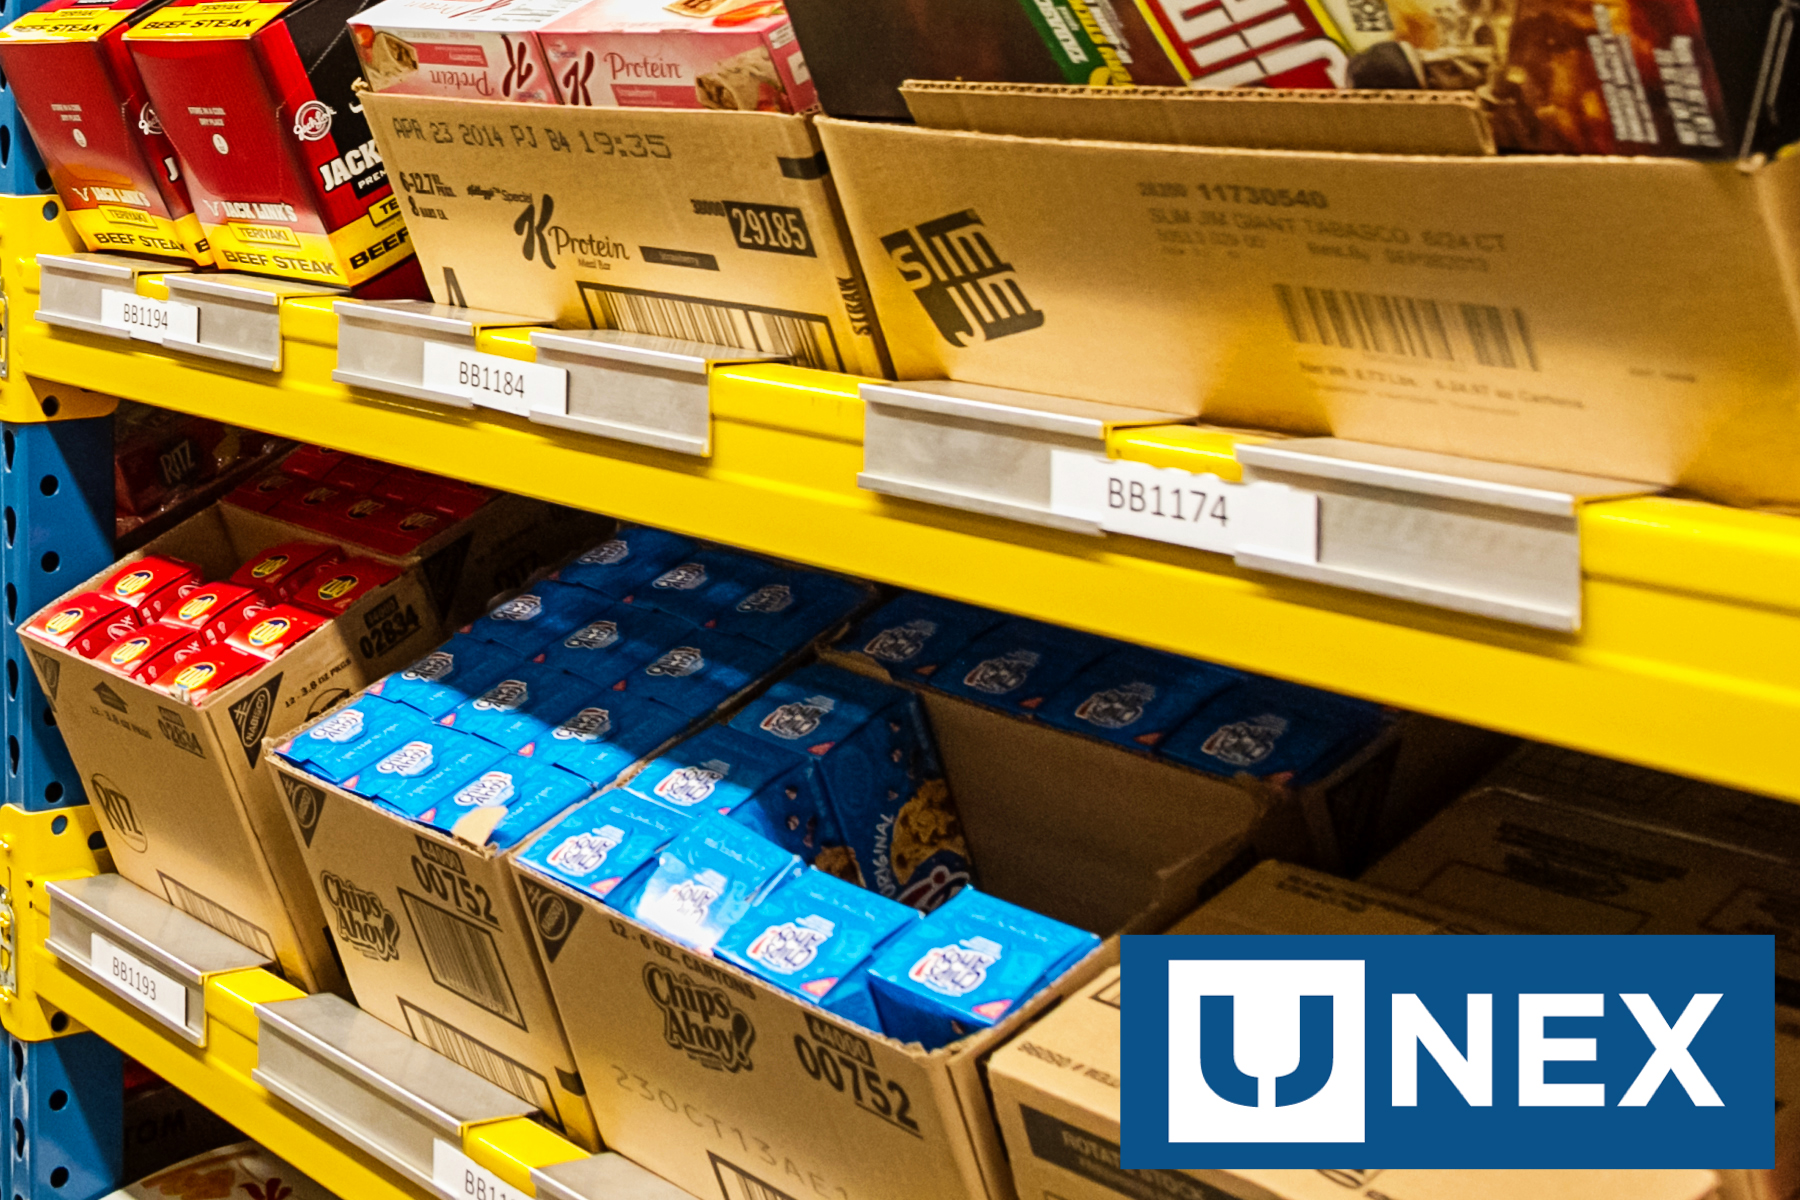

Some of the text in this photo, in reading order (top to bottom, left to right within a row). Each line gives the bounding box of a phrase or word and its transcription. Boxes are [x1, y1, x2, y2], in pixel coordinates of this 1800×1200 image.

[50, 22, 107, 35] STEAK
[142, 17, 259, 31] BEEF STEAK
[430, 69, 496, 98] Protein
[602, 52, 683, 81] Protein
[393, 117, 425, 141] APR
[429, 122, 454, 144] 23
[462, 124, 504, 148] 2014
[584, 131, 672, 160] 19:35
[107, 210, 148, 225] TERIYAKI
[223, 200, 257, 220] JACK
[513, 193, 630, 270] K Protein
[732, 207, 809, 251] 29185
[97, 232, 137, 247] BEEF
[237, 226, 290, 245] TERIYAKI
[223, 250, 339, 277] BEEF STEAK
[123, 302, 168, 330] BB1194
[458, 361, 525, 399] BB1184
[159, 441, 195, 483] RITZ
[1107, 476, 1231, 530] BB1174
[359, 603, 420, 660] 02834
[246, 693, 267, 743] NABISCO
[91, 778, 145, 837] RITZ
[321, 871, 383, 925] Chips
[412, 857, 499, 924] 00752
[336, 900, 402, 961] Ahoy!
[111, 955, 158, 1001] BB1193
[608, 918, 630, 942] 12
[639, 933, 652, 951] 6
[680, 953, 757, 1001] CARTONS
[643, 961, 732, 1021] Chips
[663, 1007, 757, 1073] Ahoy!
[792, 1032, 920, 1133] 00752
